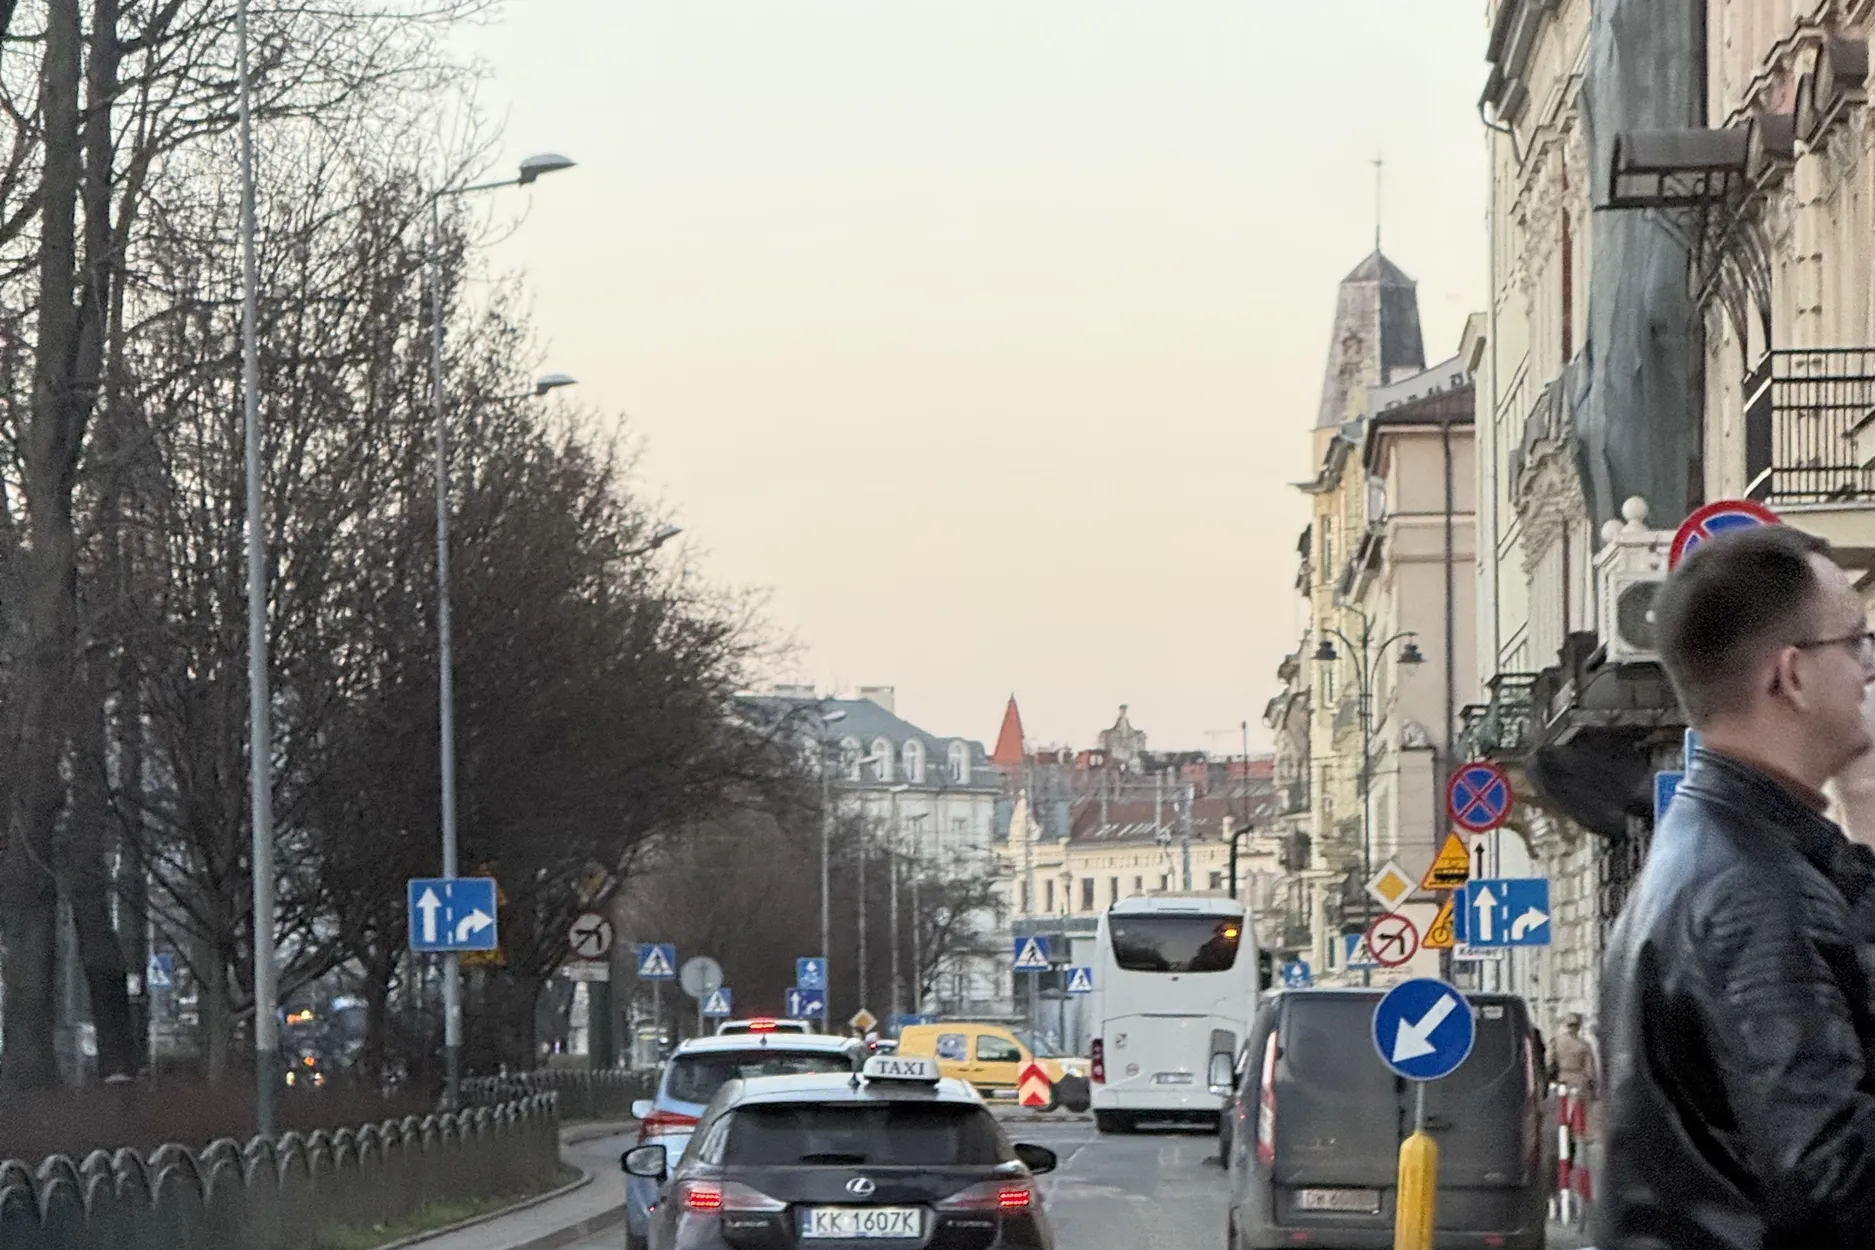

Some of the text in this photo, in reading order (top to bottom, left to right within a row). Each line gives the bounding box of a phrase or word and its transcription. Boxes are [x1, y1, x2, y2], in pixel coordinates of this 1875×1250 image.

[876, 1060, 926, 1076] TAXI
[815, 1211, 914, 1232] KK 1607K
